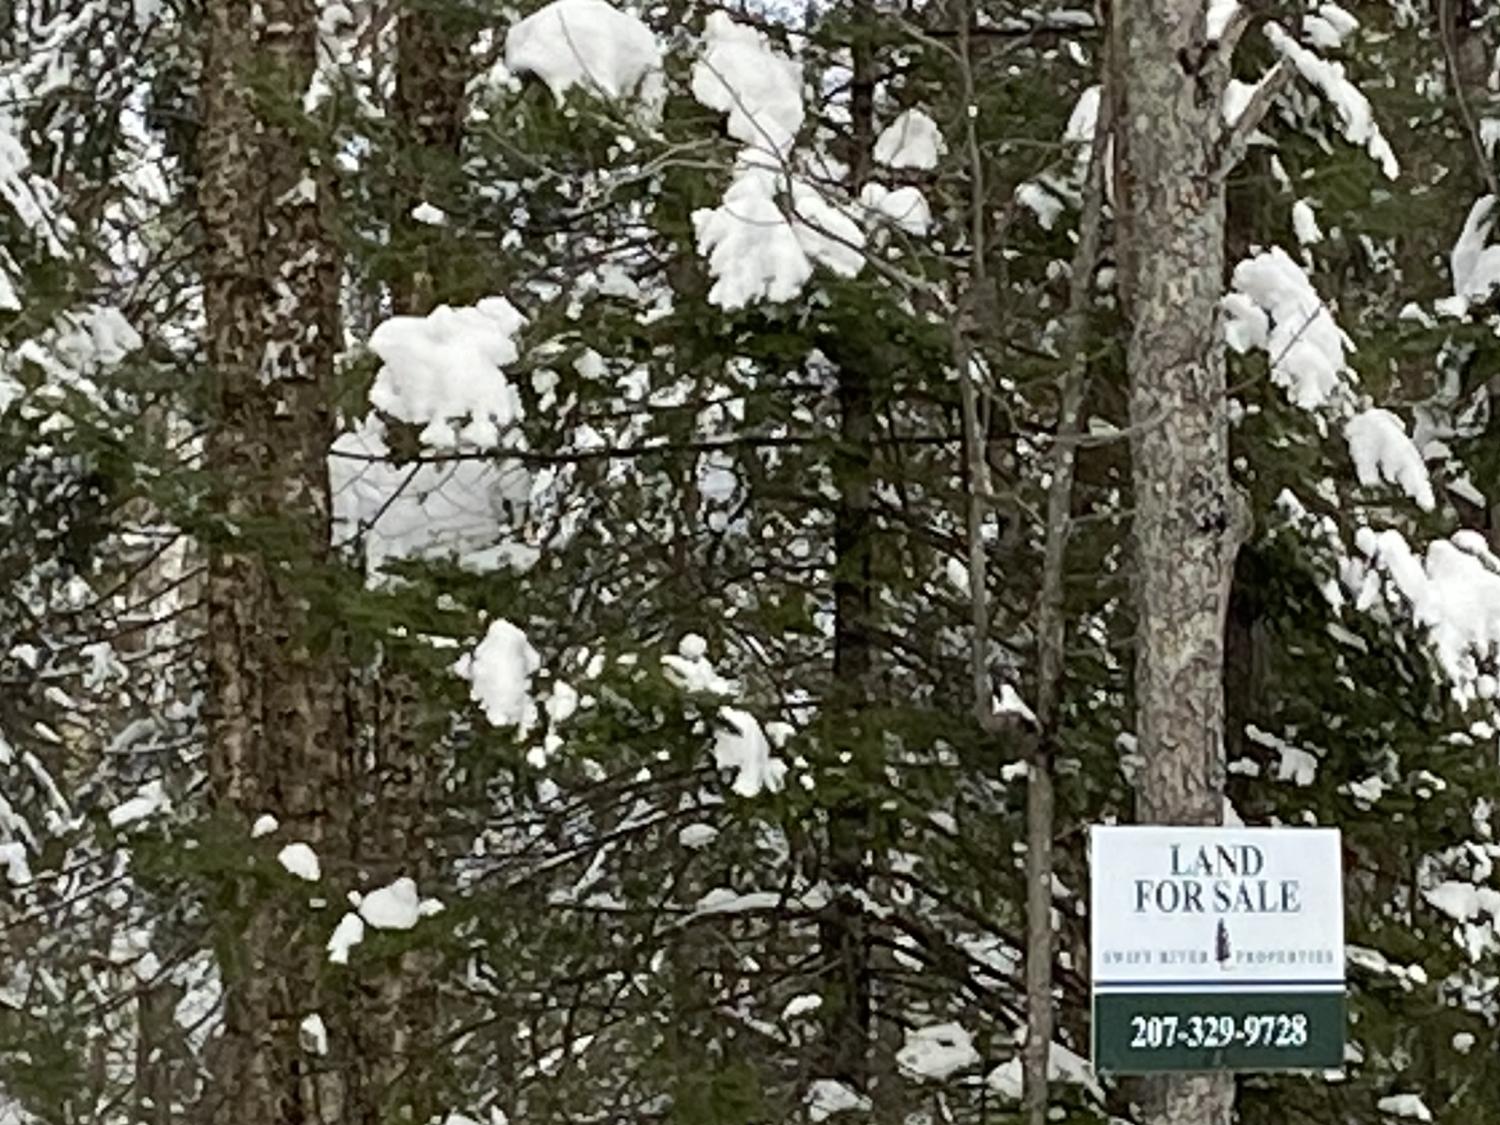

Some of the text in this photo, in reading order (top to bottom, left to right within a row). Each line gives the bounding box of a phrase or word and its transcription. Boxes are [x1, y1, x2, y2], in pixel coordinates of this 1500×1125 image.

[1170, 844, 1264, 876] LAND
[1134, 880, 1301, 913] FOR SALE
[1131, 1014, 1307, 1047] 207-329-9728
